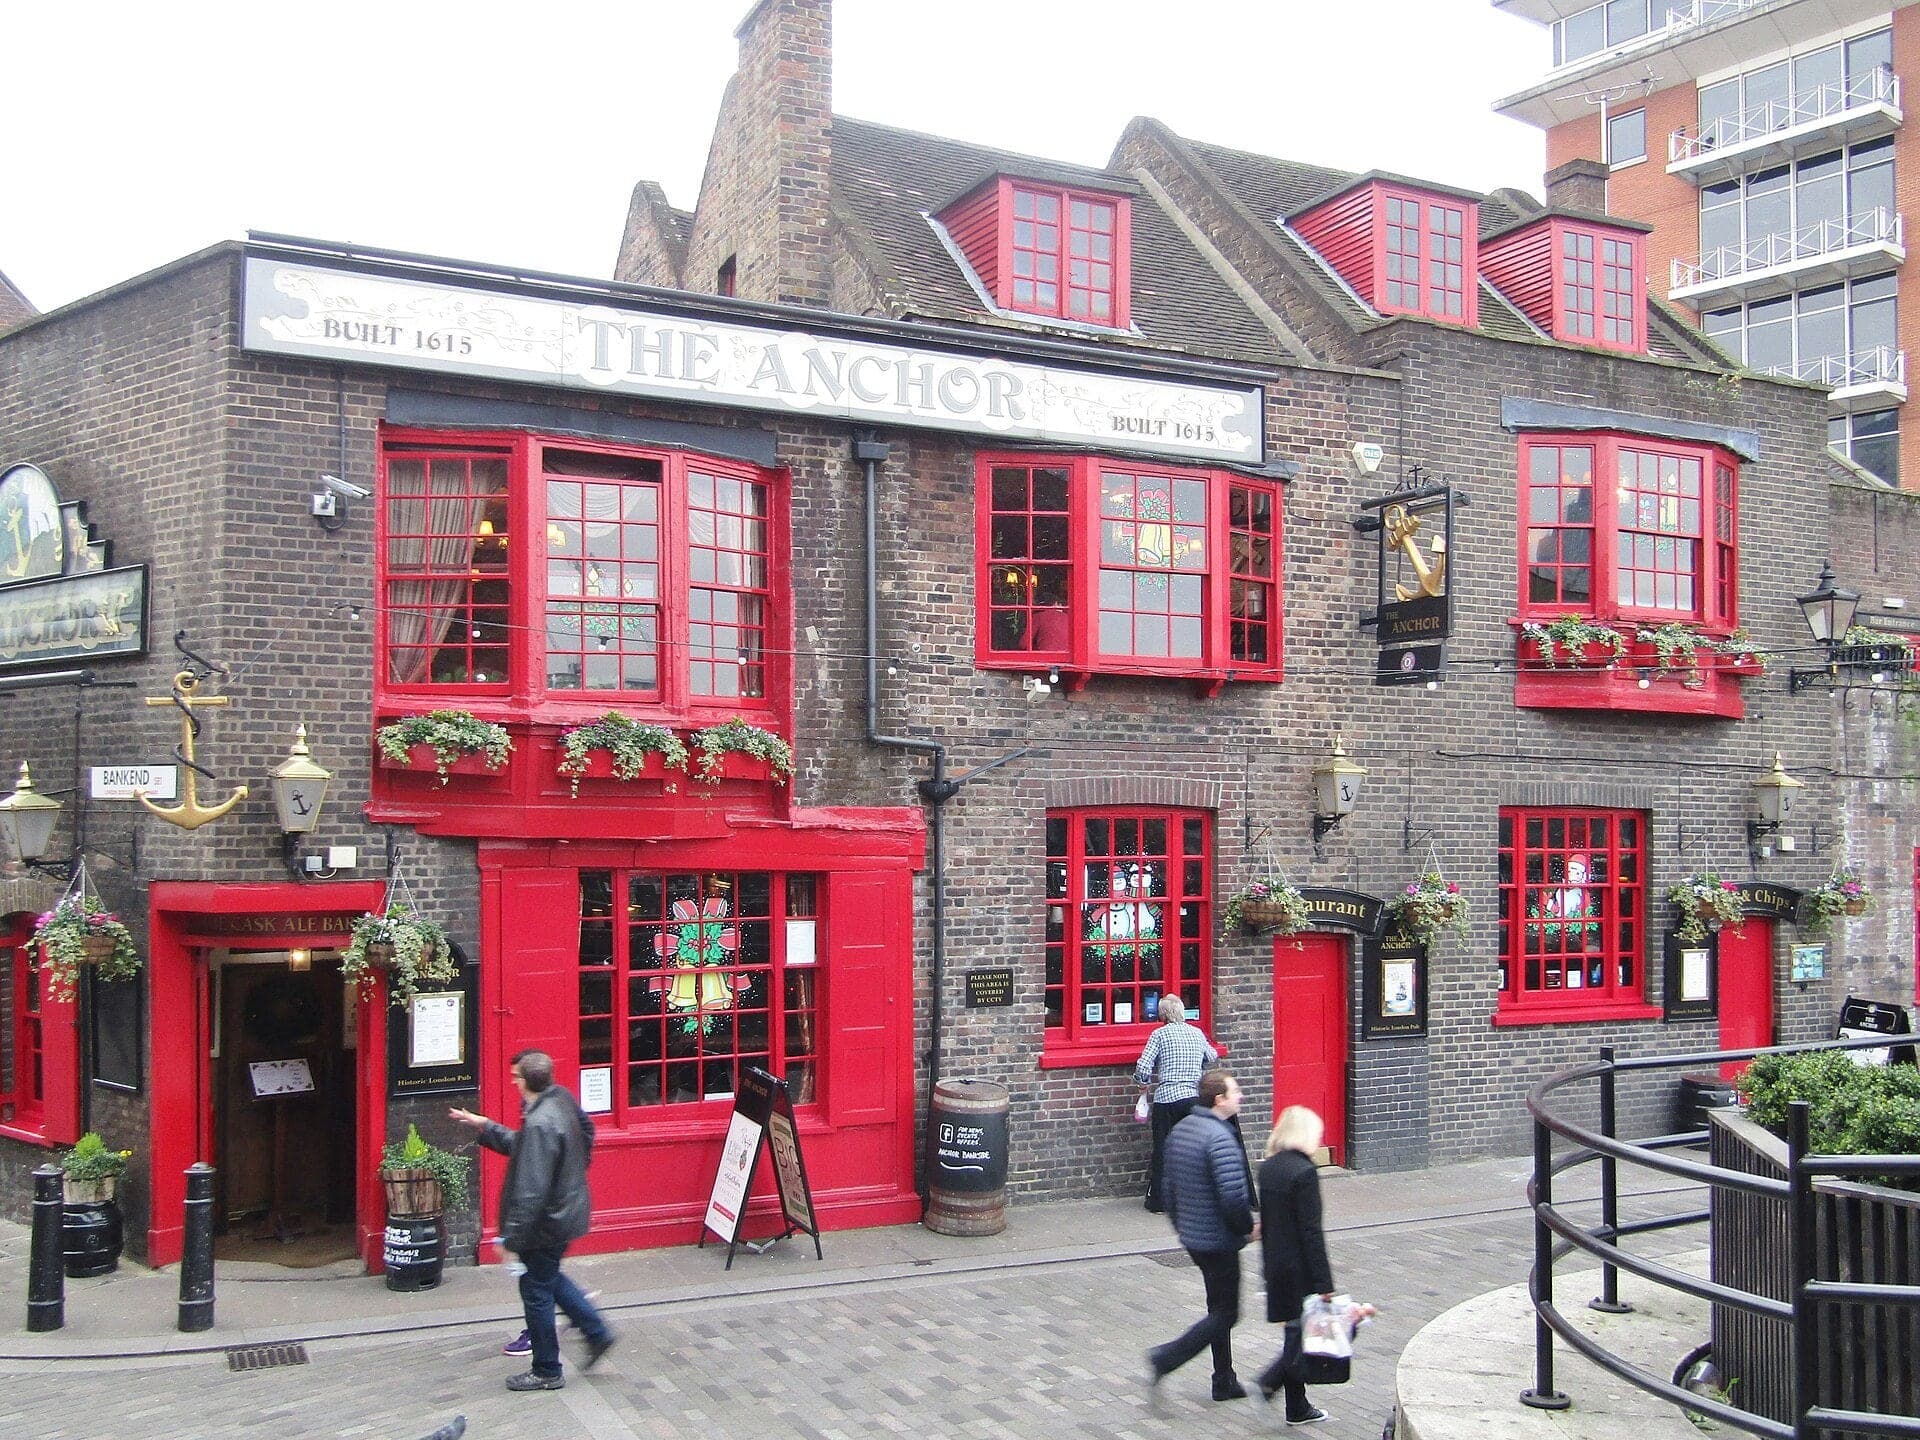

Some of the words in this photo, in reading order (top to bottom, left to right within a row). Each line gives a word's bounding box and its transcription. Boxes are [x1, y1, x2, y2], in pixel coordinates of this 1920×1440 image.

[323, 319, 403, 346] BUILT
[415, 330, 473, 355] 1615
[578, 316, 720, 386] THE
[746, 343, 1026, 421] ANCHOR
[1113, 416, 1167, 436] BUILT
[1175, 423, 1215, 442] 1615
[0, 597, 99, 649] NCHOR
[1385, 611, 1399, 620] THE
[1870, 616, 1882, 625] Bar
[1391, 616, 1440, 634] ANCHOR
[103, 770, 150, 786] BANKEND
[1742, 889, 1751, 902] &
[1754, 889, 1790, 911] Chips
[1304, 900, 1366, 918] aurant
[230, 917, 278, 933] CASK
[284, 917, 320, 933] ALE
[1380, 941, 1411, 950] ANCHOR
[397, 1078, 426, 1086] Historic
[428, 1076, 456, 1084] London
[457, 1074, 472, 1082] Pub
[938, 1148, 960, 1158] ANCHOR
[962, 1151, 991, 1160] BANKSIDE
